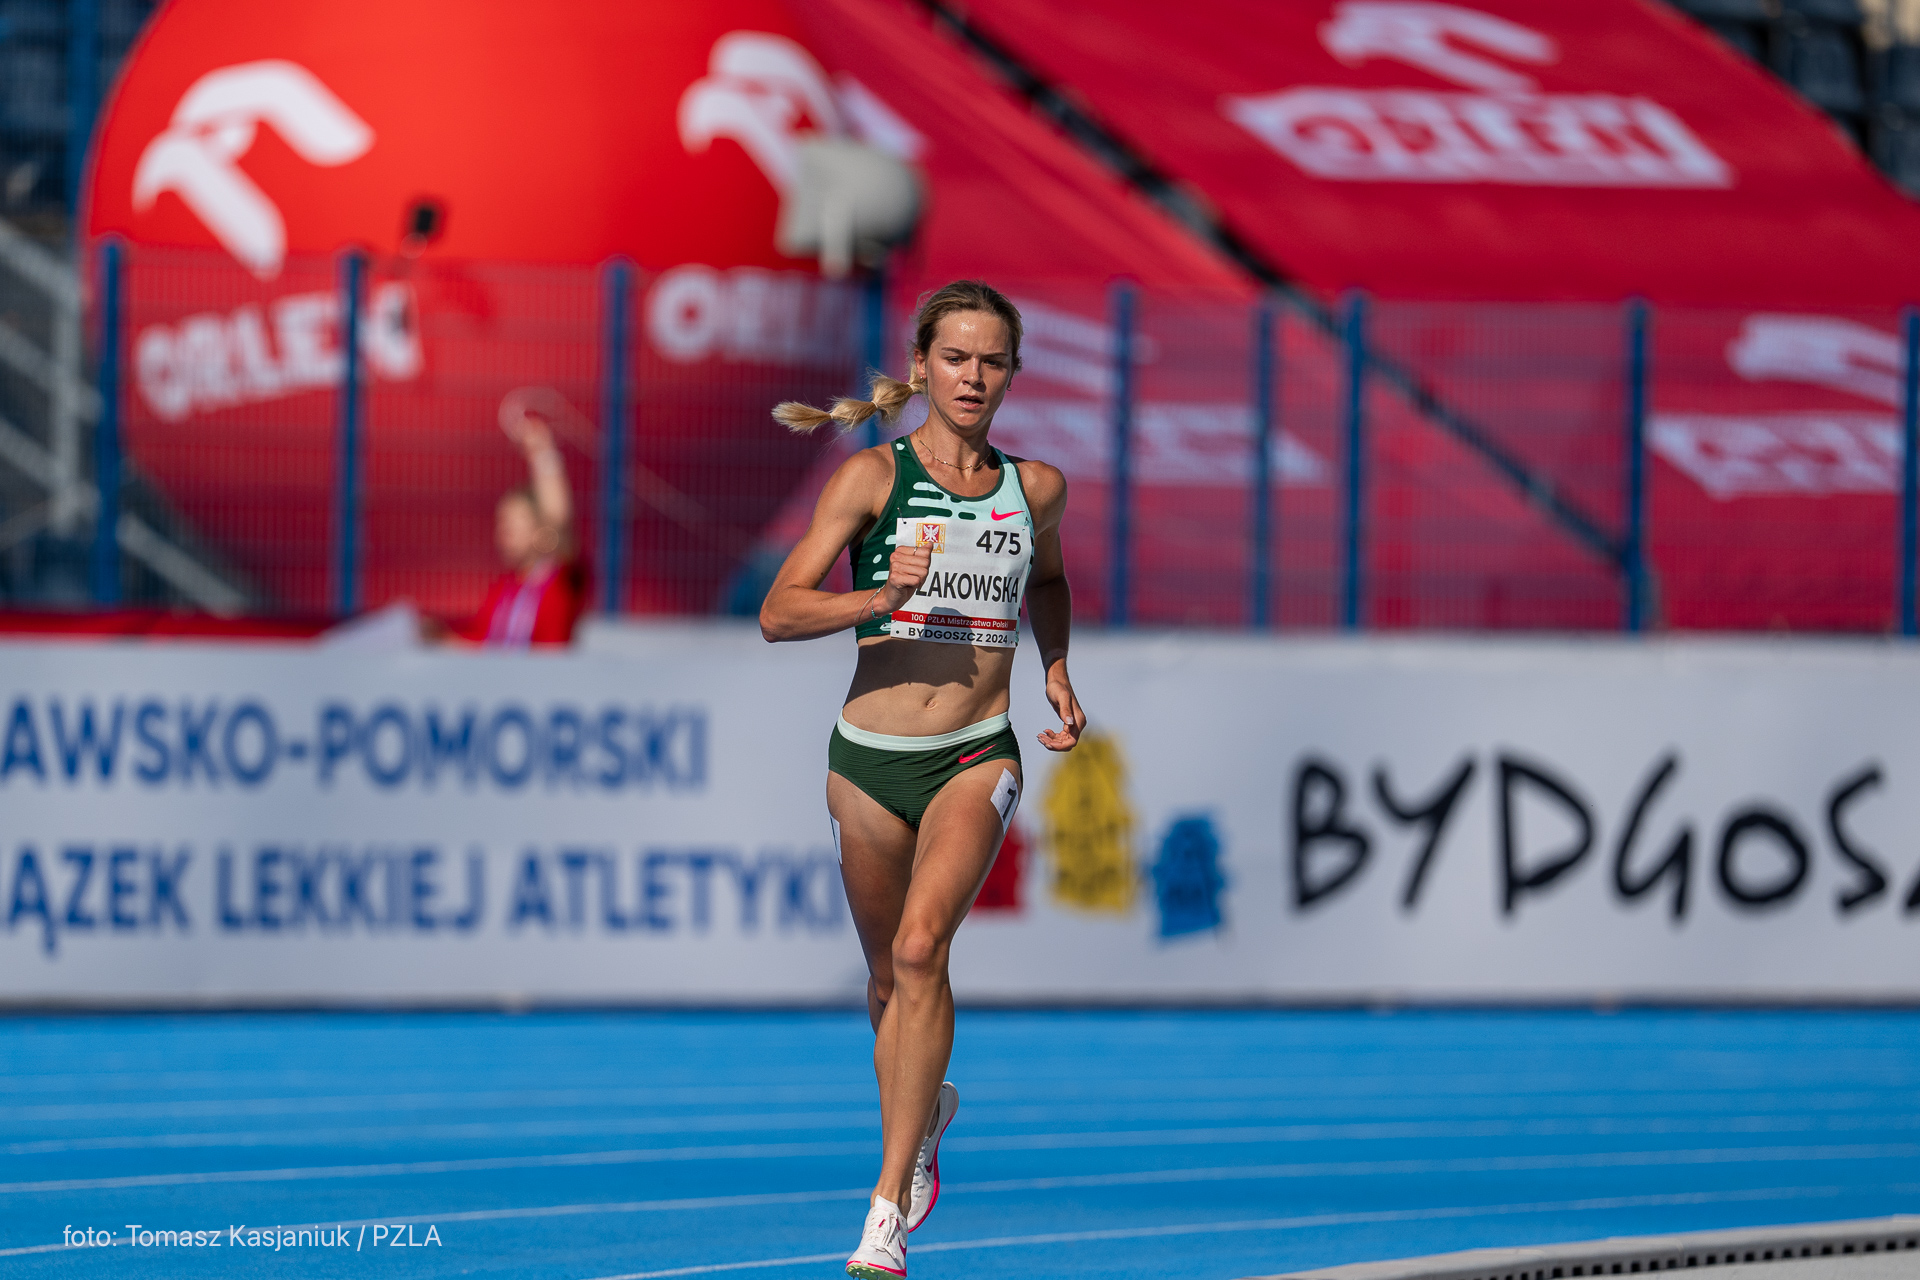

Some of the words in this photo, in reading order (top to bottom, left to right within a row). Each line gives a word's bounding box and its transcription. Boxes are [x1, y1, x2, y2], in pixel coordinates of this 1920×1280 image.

[976, 530, 1021, 555] 475
[911, 613, 926, 622] 100.
[927, 615, 946, 624] PZLA
[947, 617, 991, 627] Mistrzostwa
[992, 621, 1009, 629] Polski
[908, 627, 983, 642] BYDGOSZCZ
[985, 634, 1008, 644] 2024
[0, 697, 708, 788] AWSKO-POMORSKI
[217, 846, 486, 932] LEKKIEJ
[507, 846, 843, 932] ATLETYKI
